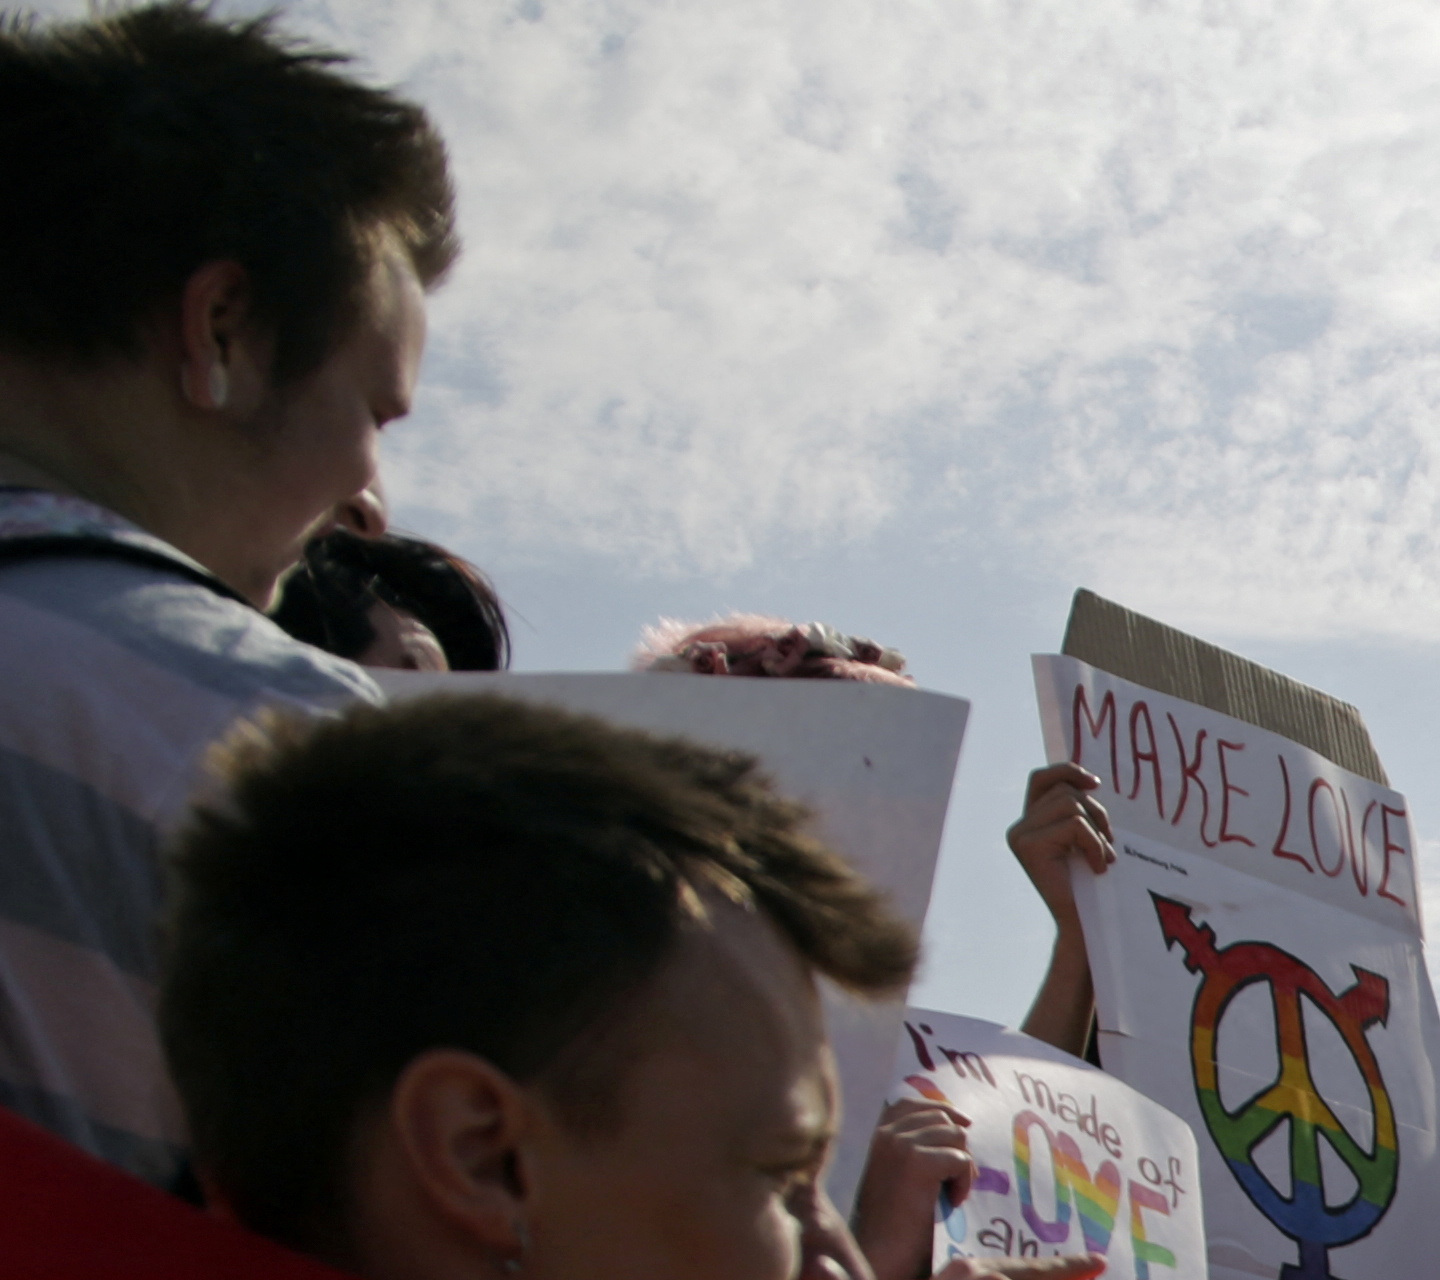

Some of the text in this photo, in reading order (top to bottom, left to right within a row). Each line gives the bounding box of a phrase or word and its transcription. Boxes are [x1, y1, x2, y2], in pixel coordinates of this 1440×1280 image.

[1072, 682, 1407, 907] MAKE LOVE
[1013, 1069, 1123, 1159] made
[1137, 1156, 1185, 1209] of
